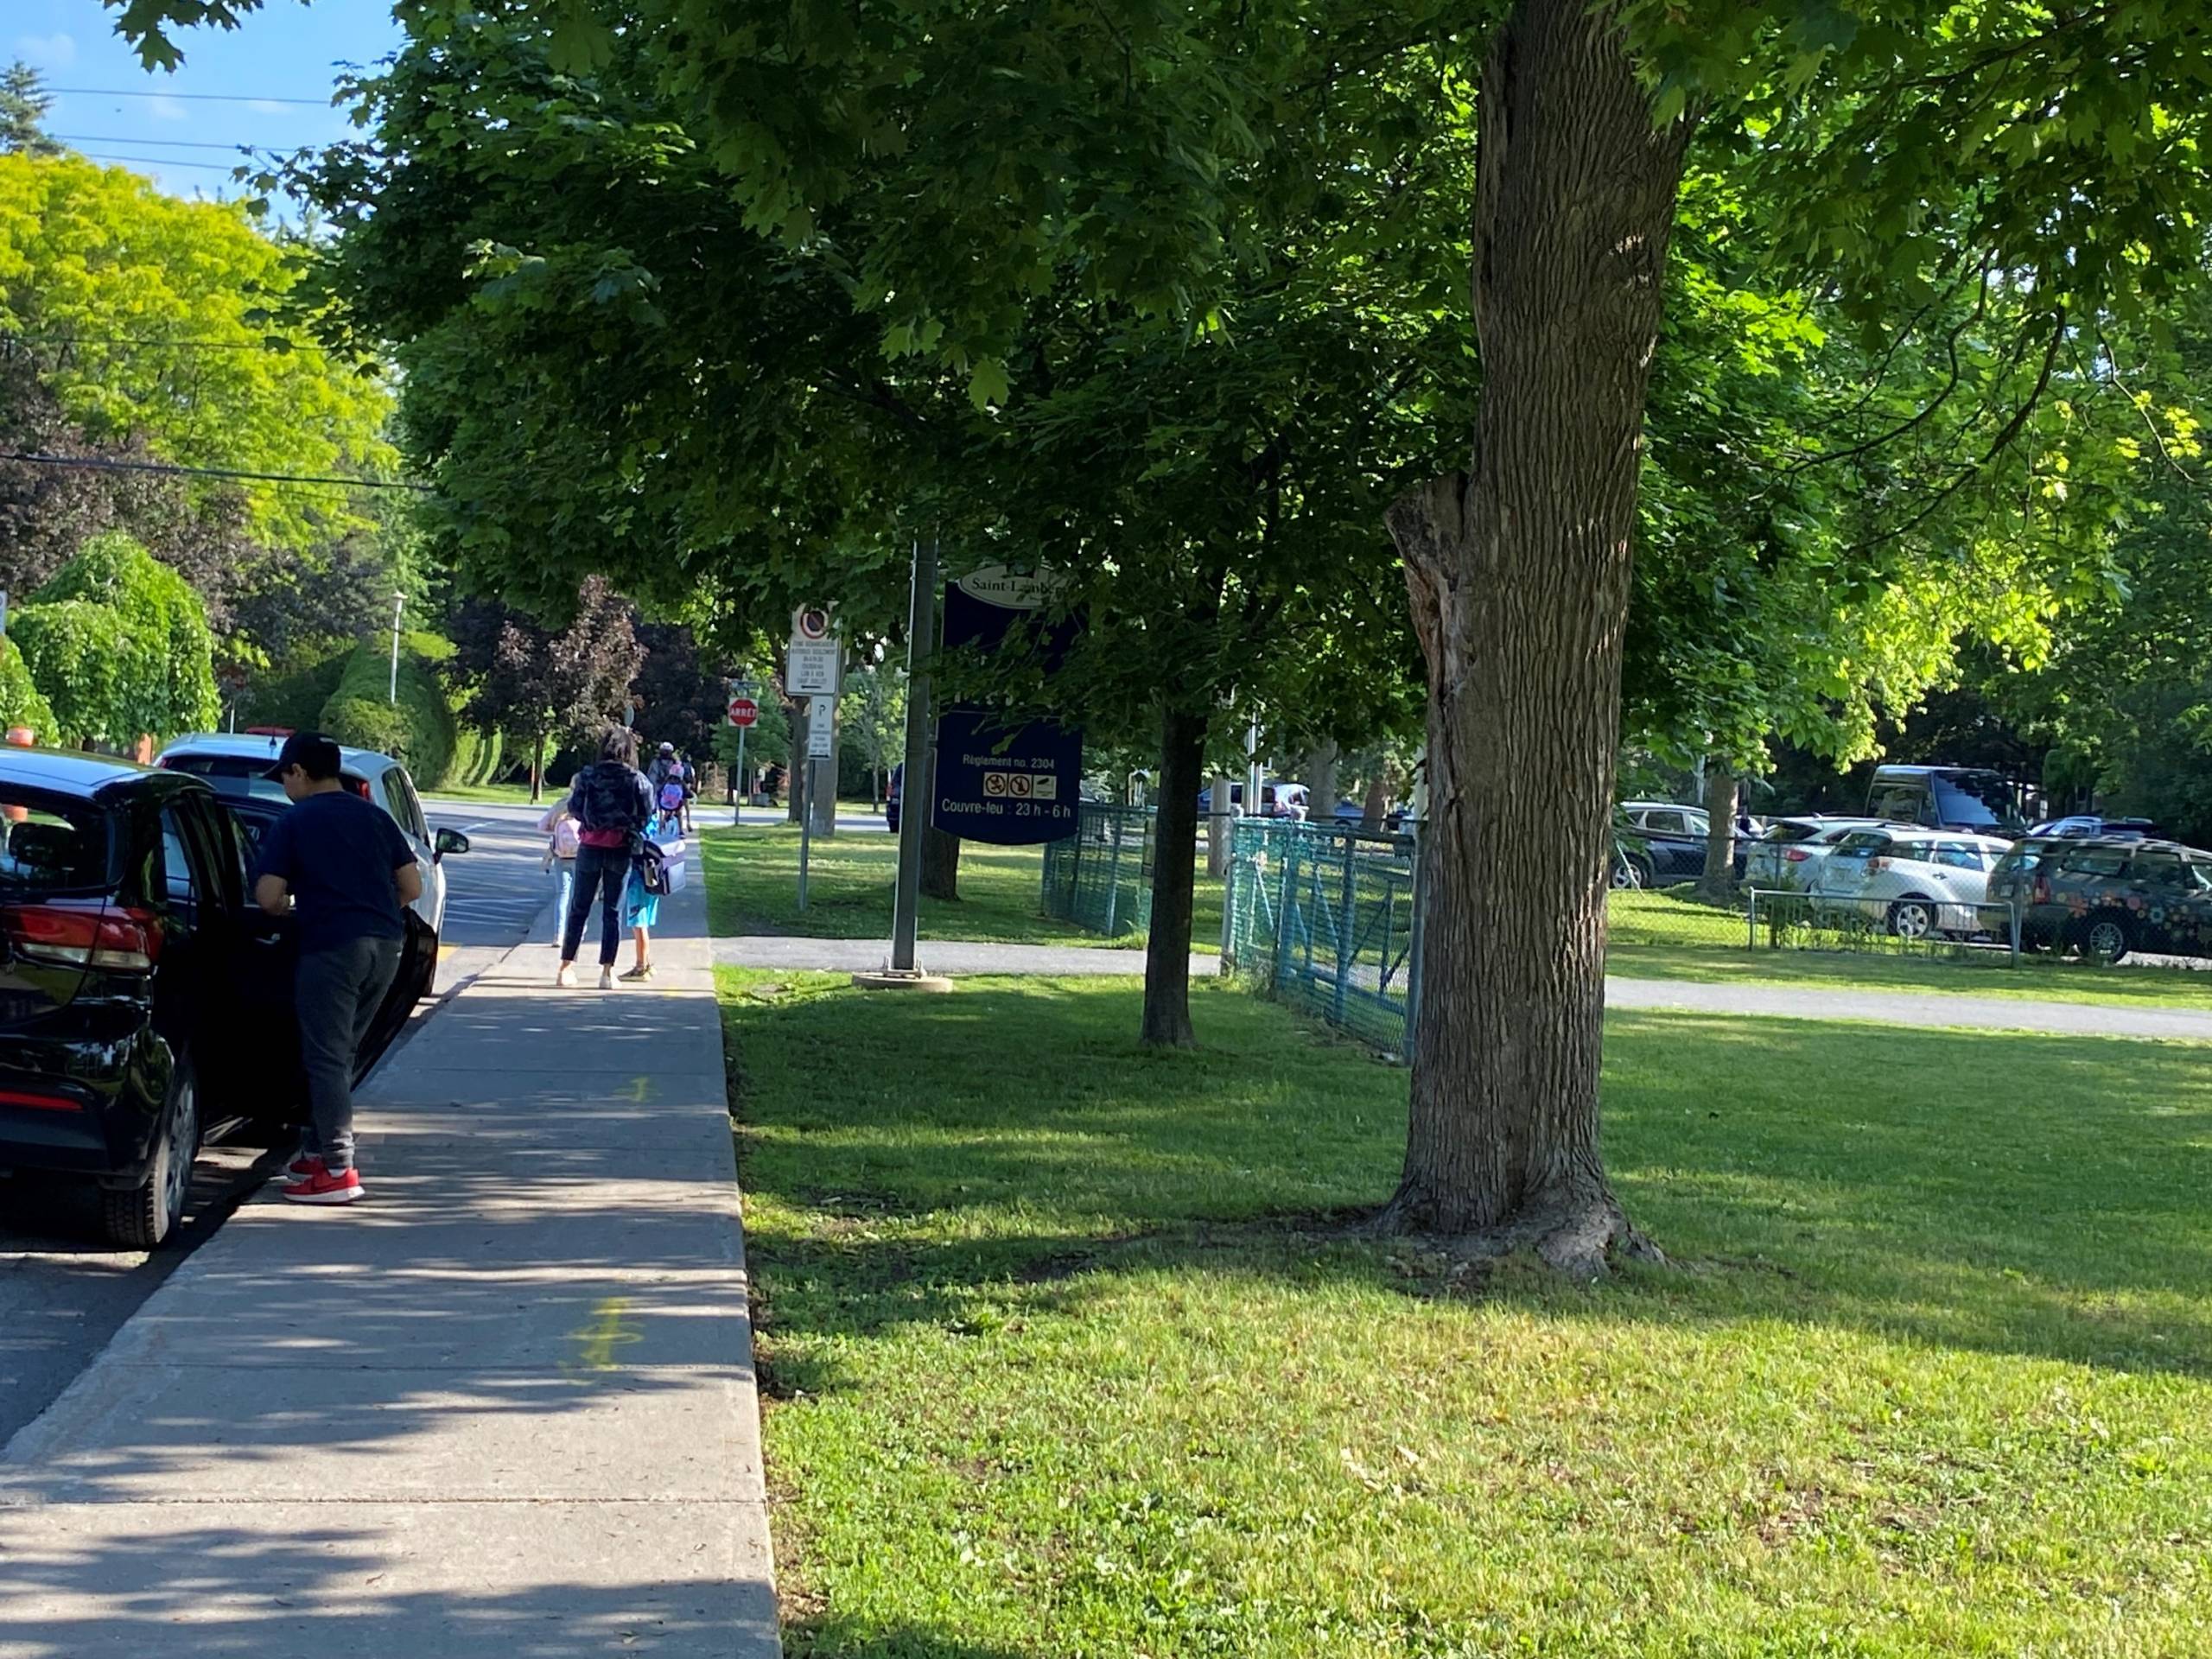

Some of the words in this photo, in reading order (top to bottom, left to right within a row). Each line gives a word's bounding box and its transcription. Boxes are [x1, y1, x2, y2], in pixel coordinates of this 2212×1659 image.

[963, 753, 1012, 767] Règlement
[1031, 758, 1055, 769] 2304
[942, 798, 1003, 814] Couvre-feu
[1015, 803, 1031, 817] 23
[1033, 804, 1041, 816] h
[1052, 804, 1061, 817] 6
[1063, 806, 1071, 818] h
